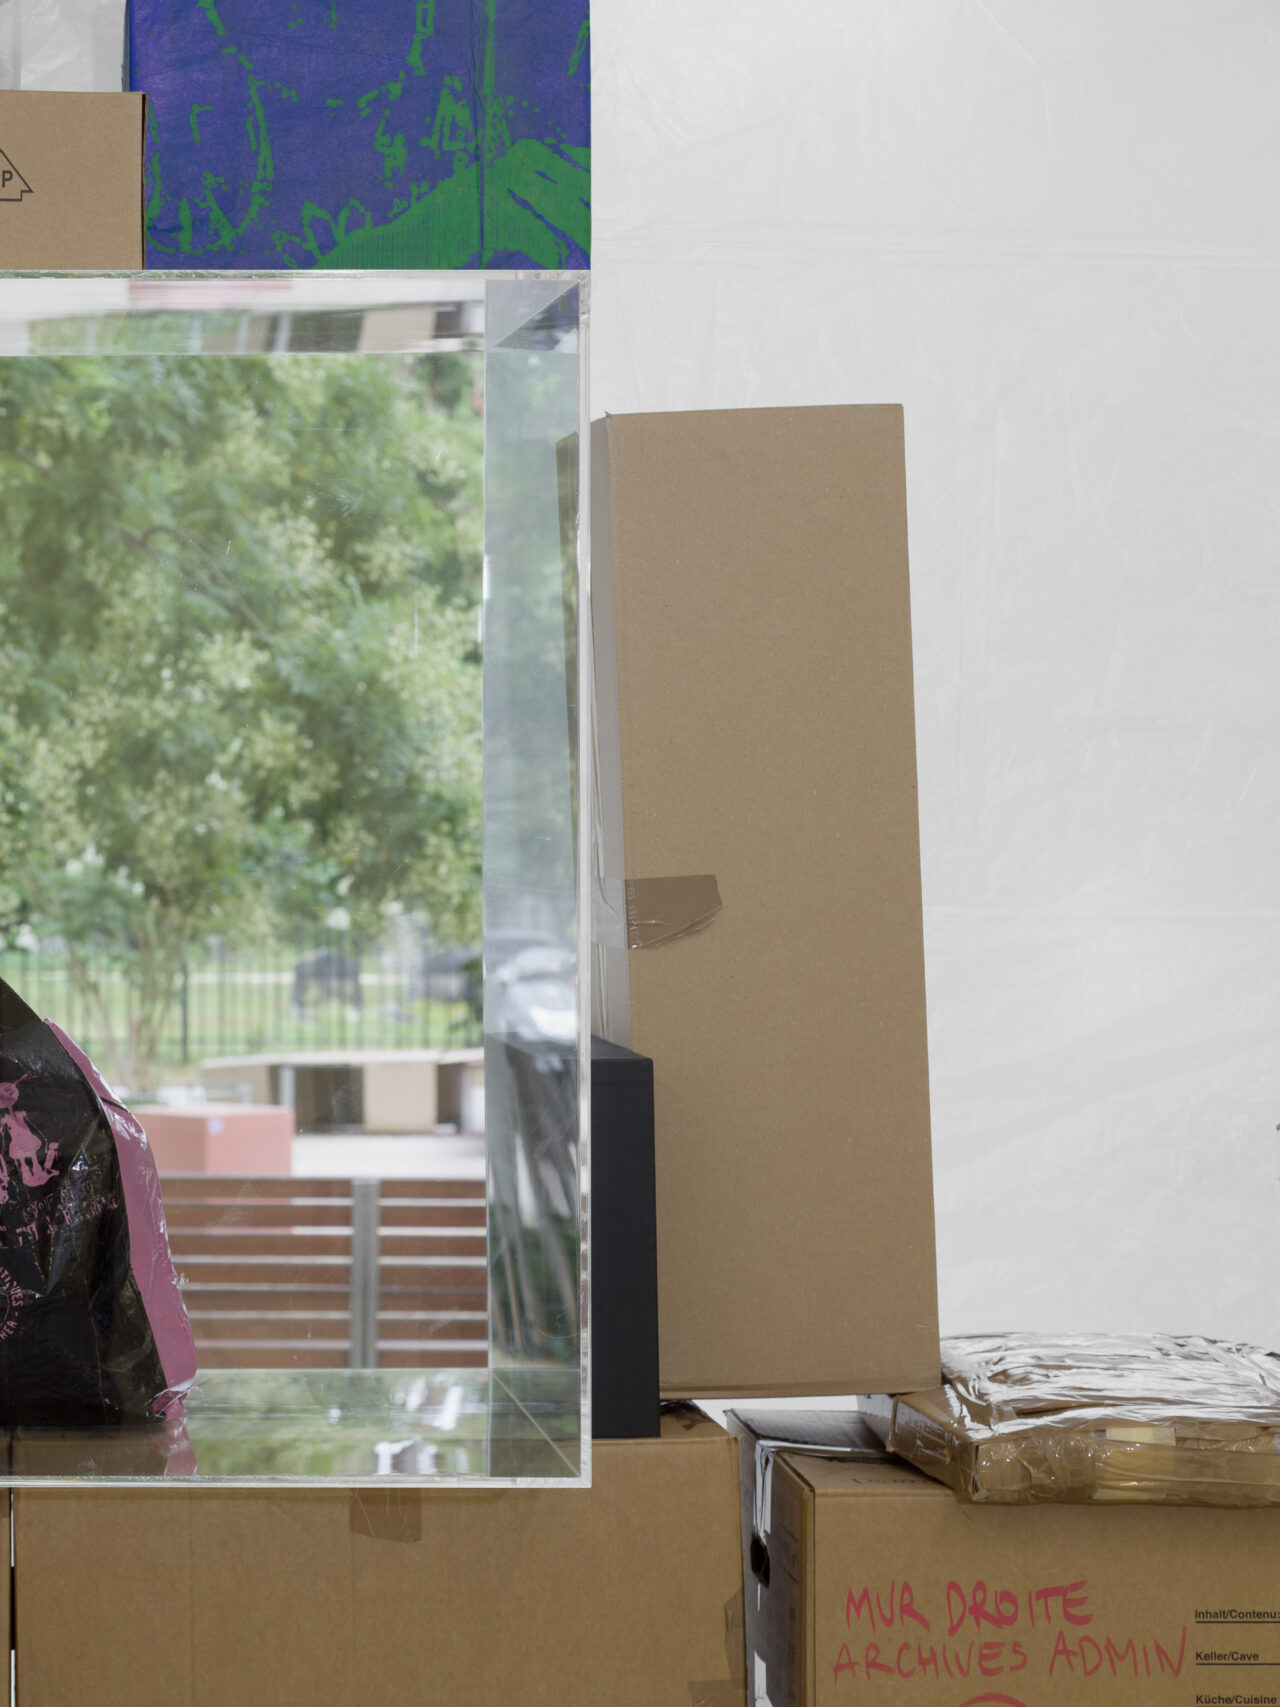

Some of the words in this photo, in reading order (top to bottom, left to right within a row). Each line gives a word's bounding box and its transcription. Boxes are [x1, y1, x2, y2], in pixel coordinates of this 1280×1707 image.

[845, 1579, 930, 1633] MUR
[946, 1579, 1094, 1637] DROITE
[833, 1641, 1028, 1685] ARCHIVES
[1048, 1624, 1187, 1678] ADMIN
[1195, 1651, 1260, 1662] Keller/Cave
[1195, 1695, 1278, 1705] Küche/Cuisine
